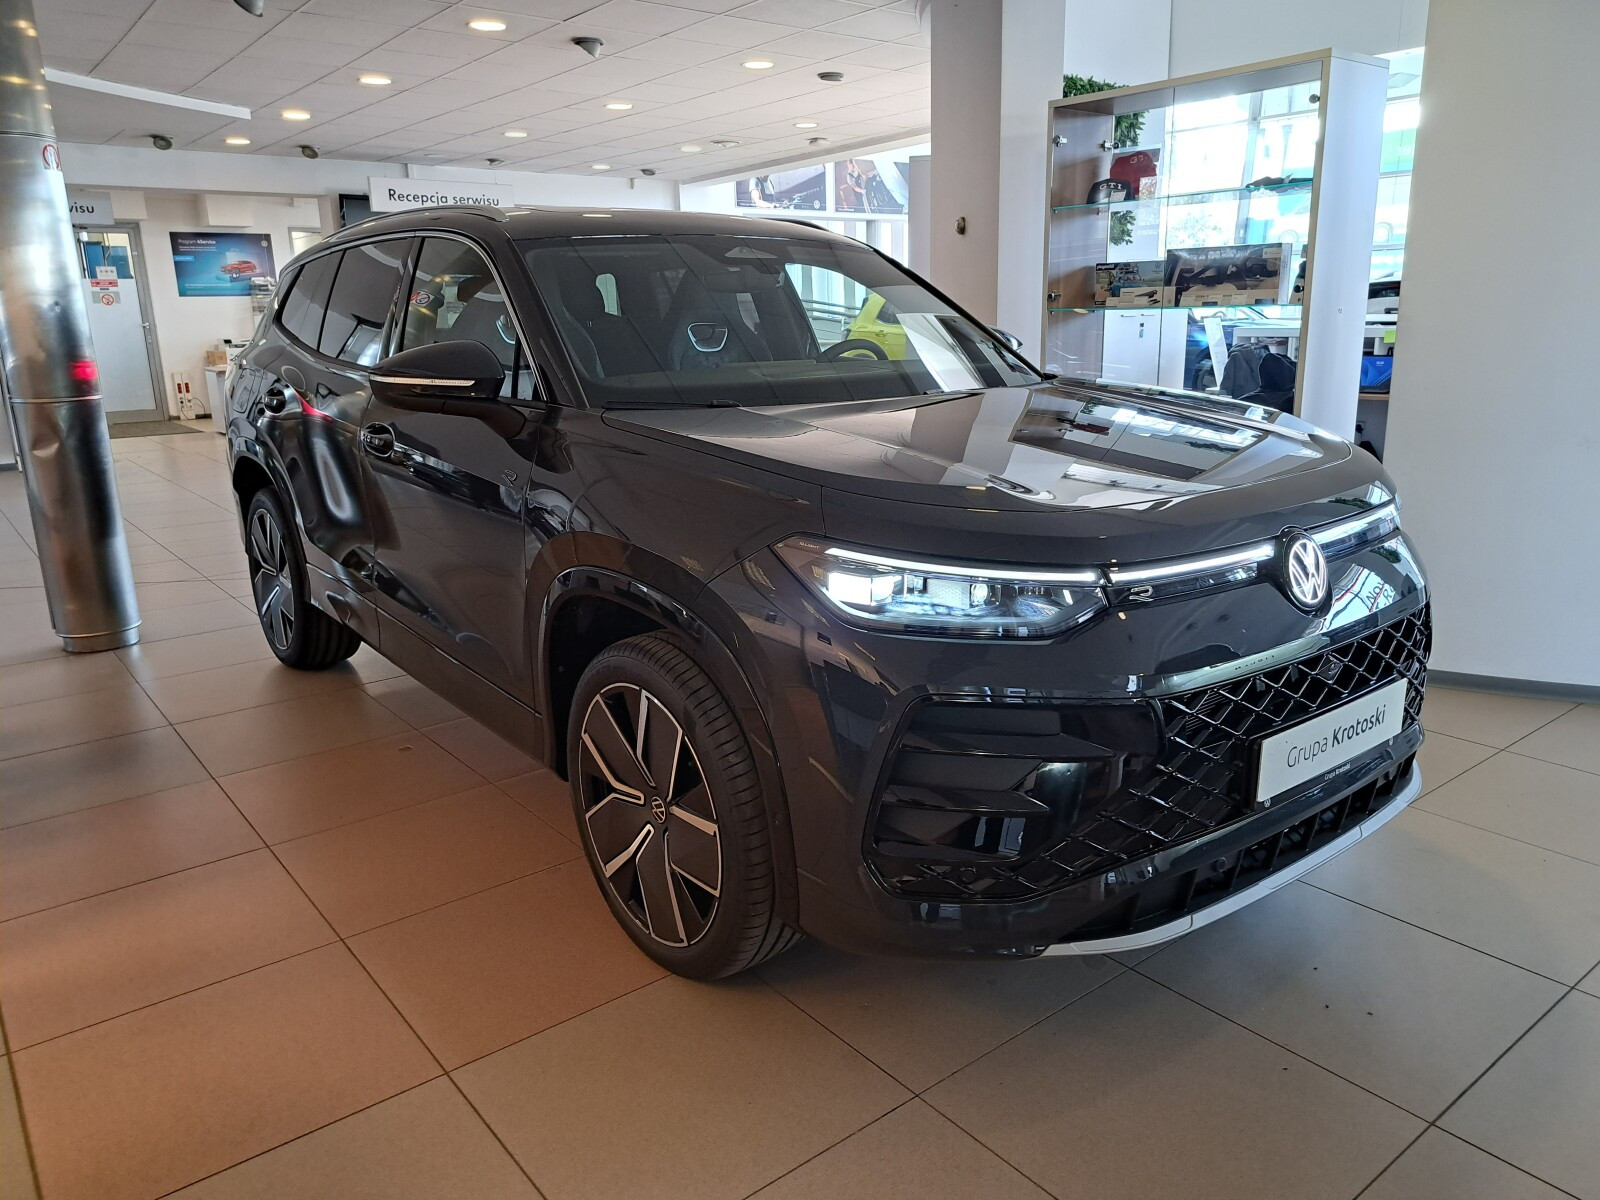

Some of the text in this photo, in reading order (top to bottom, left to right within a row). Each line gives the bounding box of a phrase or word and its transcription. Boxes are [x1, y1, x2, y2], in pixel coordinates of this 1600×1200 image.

[1100, 182, 1122, 190] GTI
[388, 188, 500, 207] Recepcja serwisu
[1287, 704, 1386, 768] Grupa Krotoski
